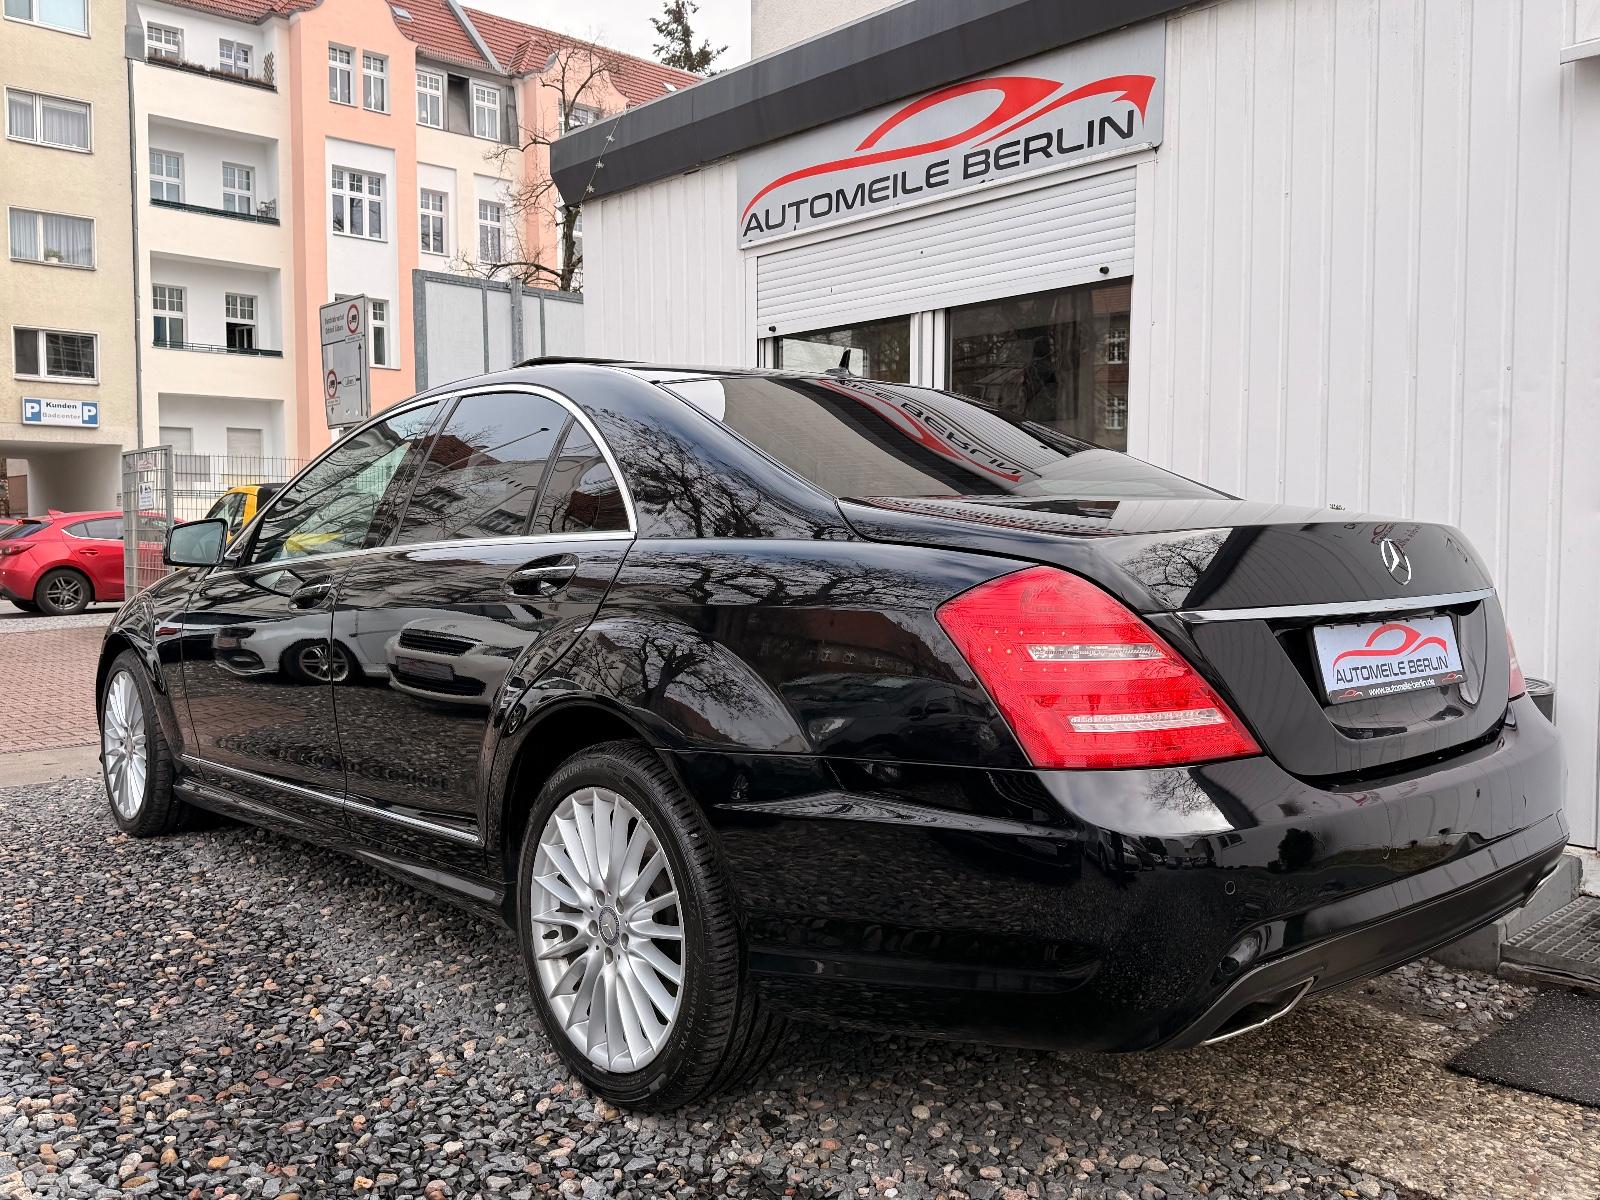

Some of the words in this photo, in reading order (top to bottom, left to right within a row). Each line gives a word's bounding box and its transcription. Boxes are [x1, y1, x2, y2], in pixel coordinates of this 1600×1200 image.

[742, 159, 950, 238] AUTOMEILE
[962, 109, 1135, 181] BERLIN
[25, 402, 40, 418] P
[46, 401, 77, 410] Kunden
[42, 412, 80, 420] Badcenter
[1336, 661, 1406, 684] AUTOMEILE
[1408, 655, 1448, 674] BERLIN
